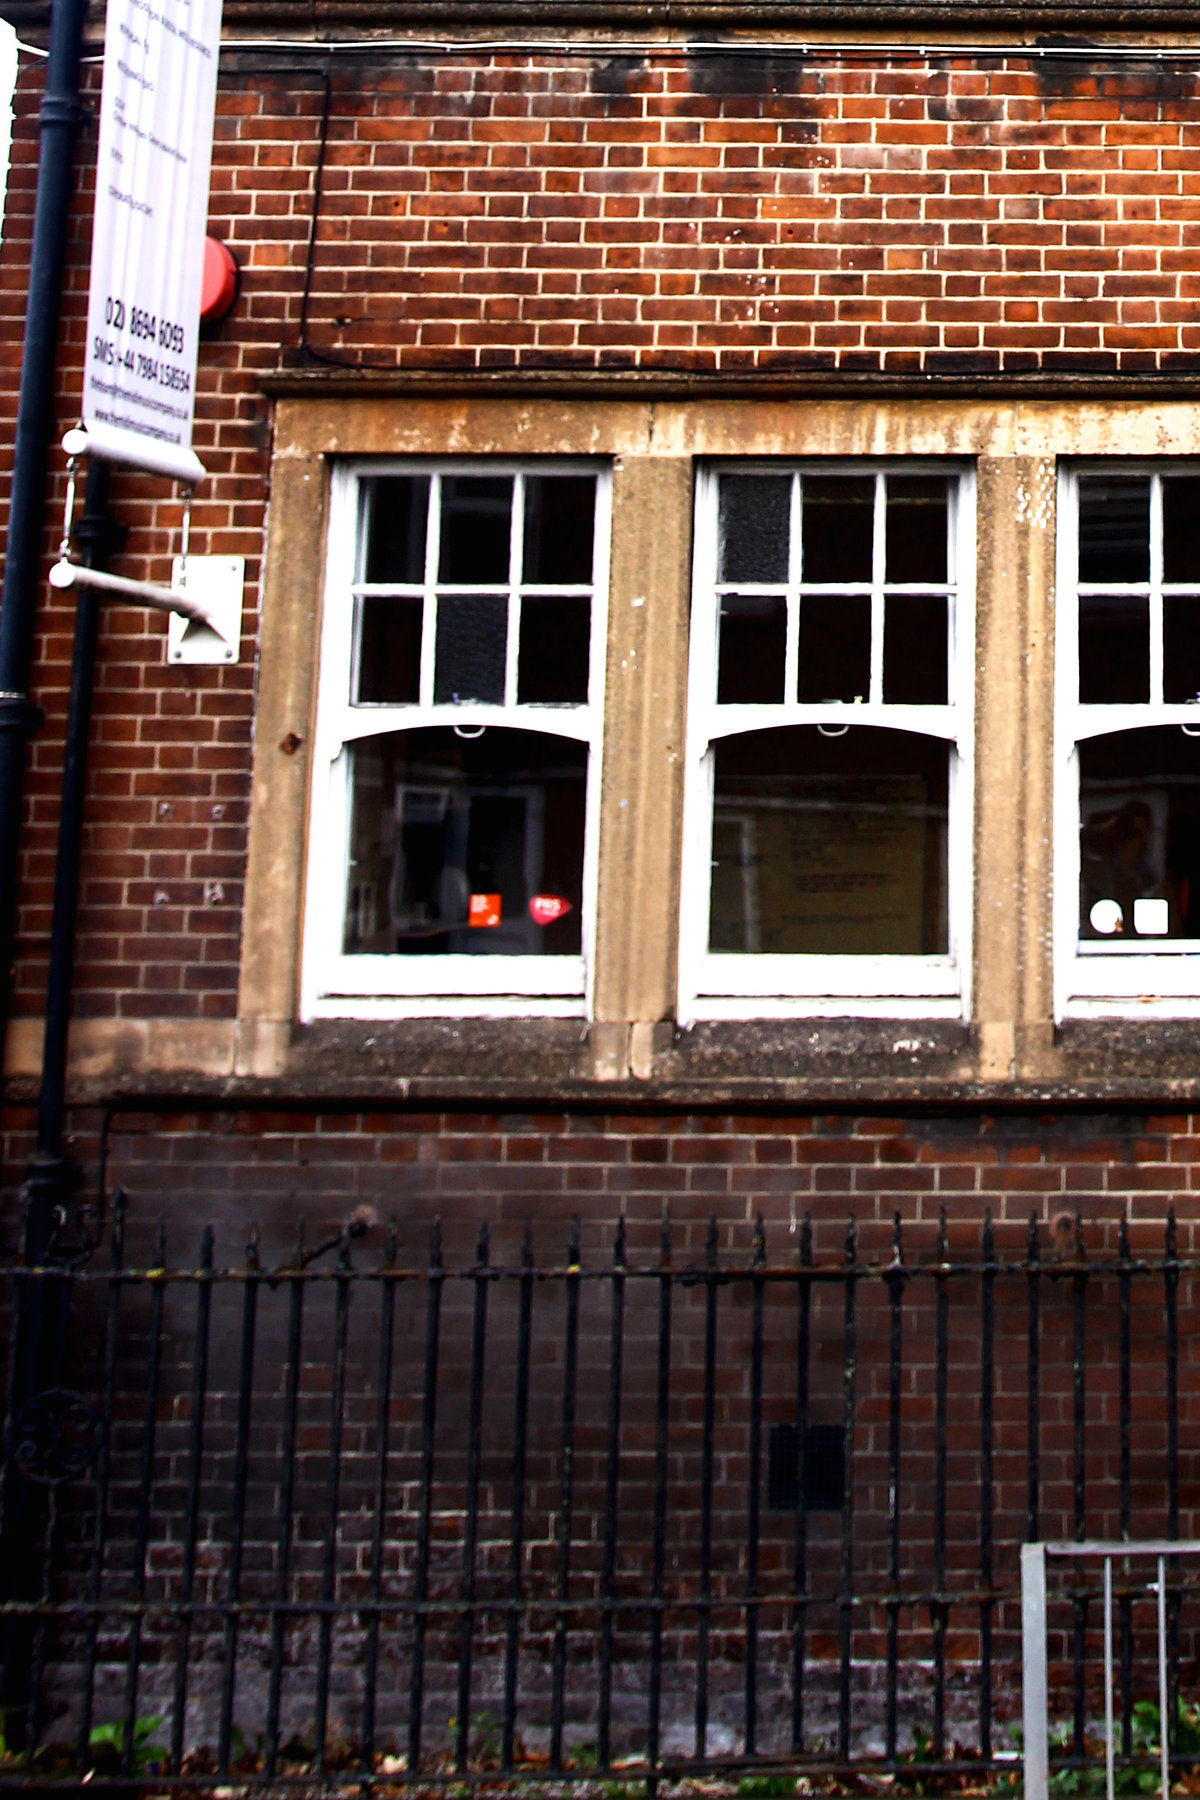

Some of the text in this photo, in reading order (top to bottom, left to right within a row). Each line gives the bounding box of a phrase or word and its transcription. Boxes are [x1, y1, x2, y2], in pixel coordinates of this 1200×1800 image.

[105, 296, 185, 354] 020 8694 6093
